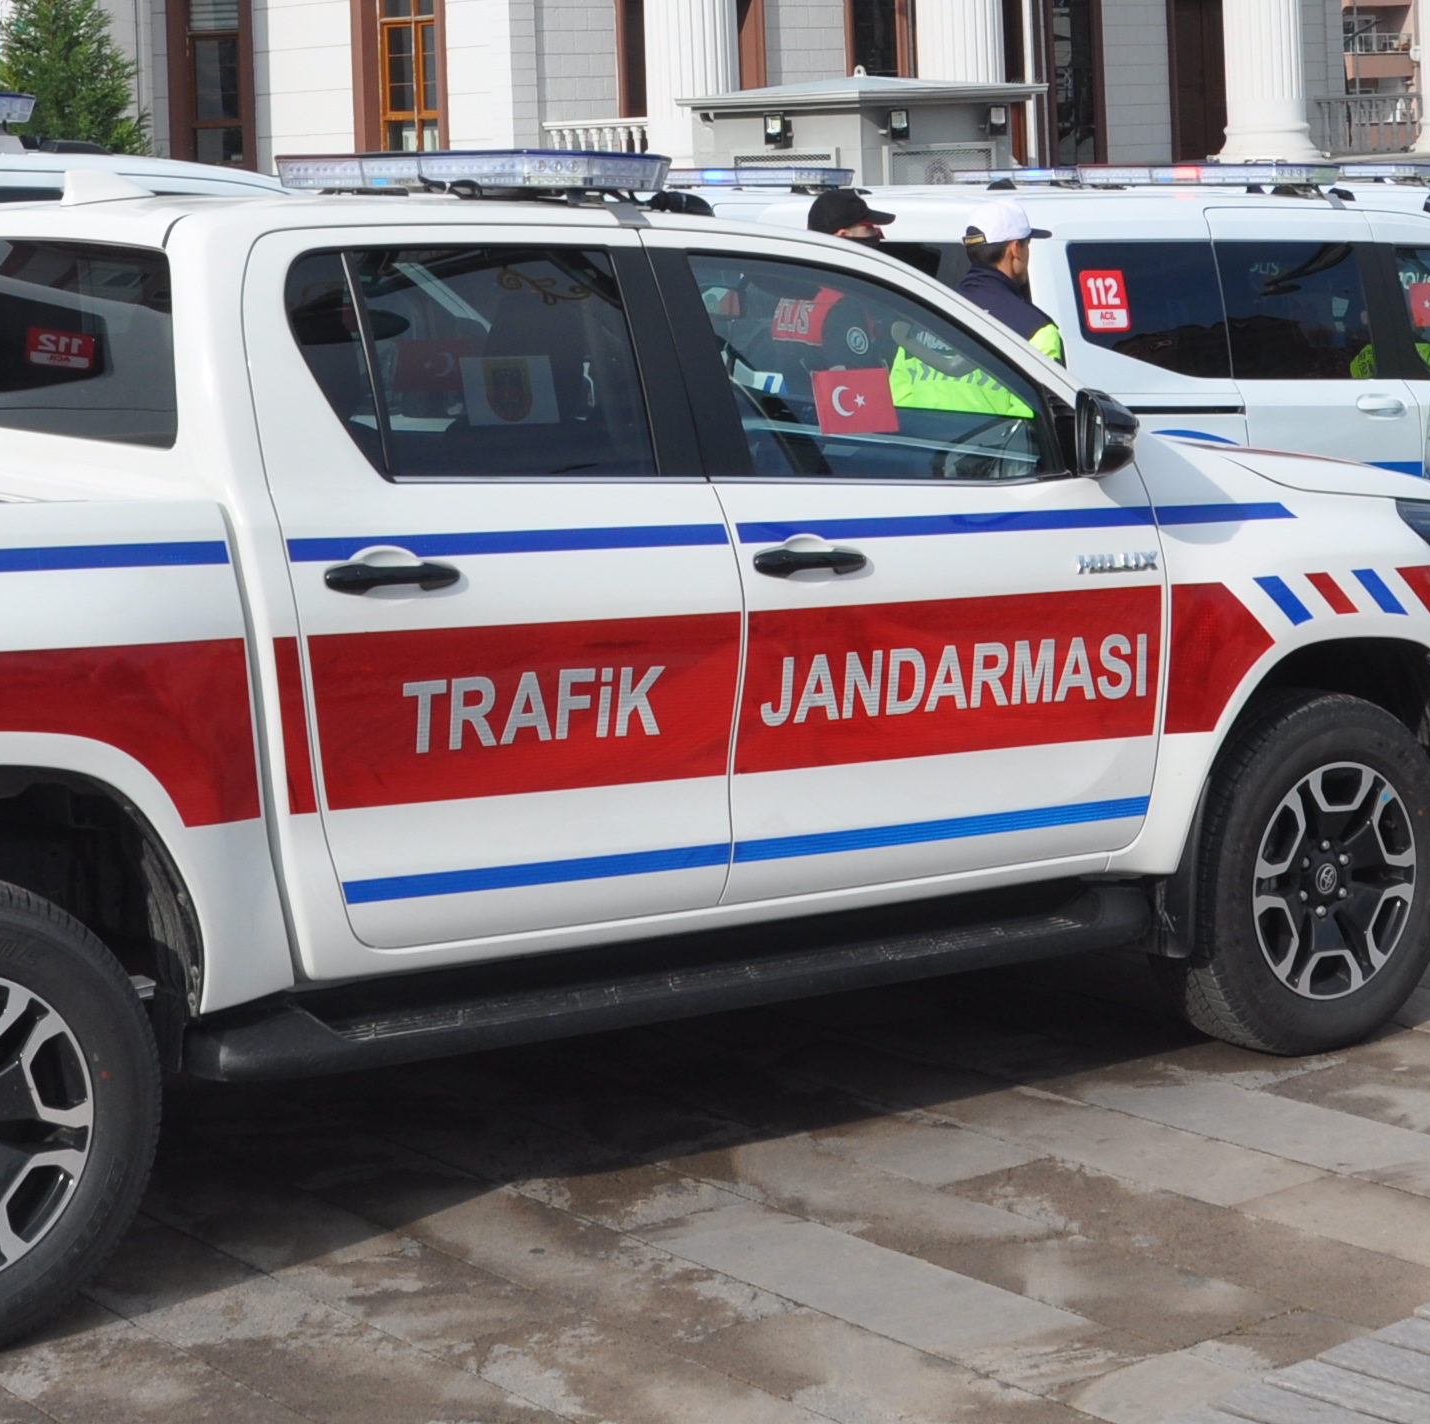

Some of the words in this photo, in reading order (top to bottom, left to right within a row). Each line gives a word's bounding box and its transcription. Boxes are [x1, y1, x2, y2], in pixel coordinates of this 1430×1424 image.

[1086, 276, 1122, 306] 112
[1076, 551, 1158, 575] HILUX
[402, 665, 666, 754] TRAFİK
[760, 633, 1148, 727] JANDARMASI
